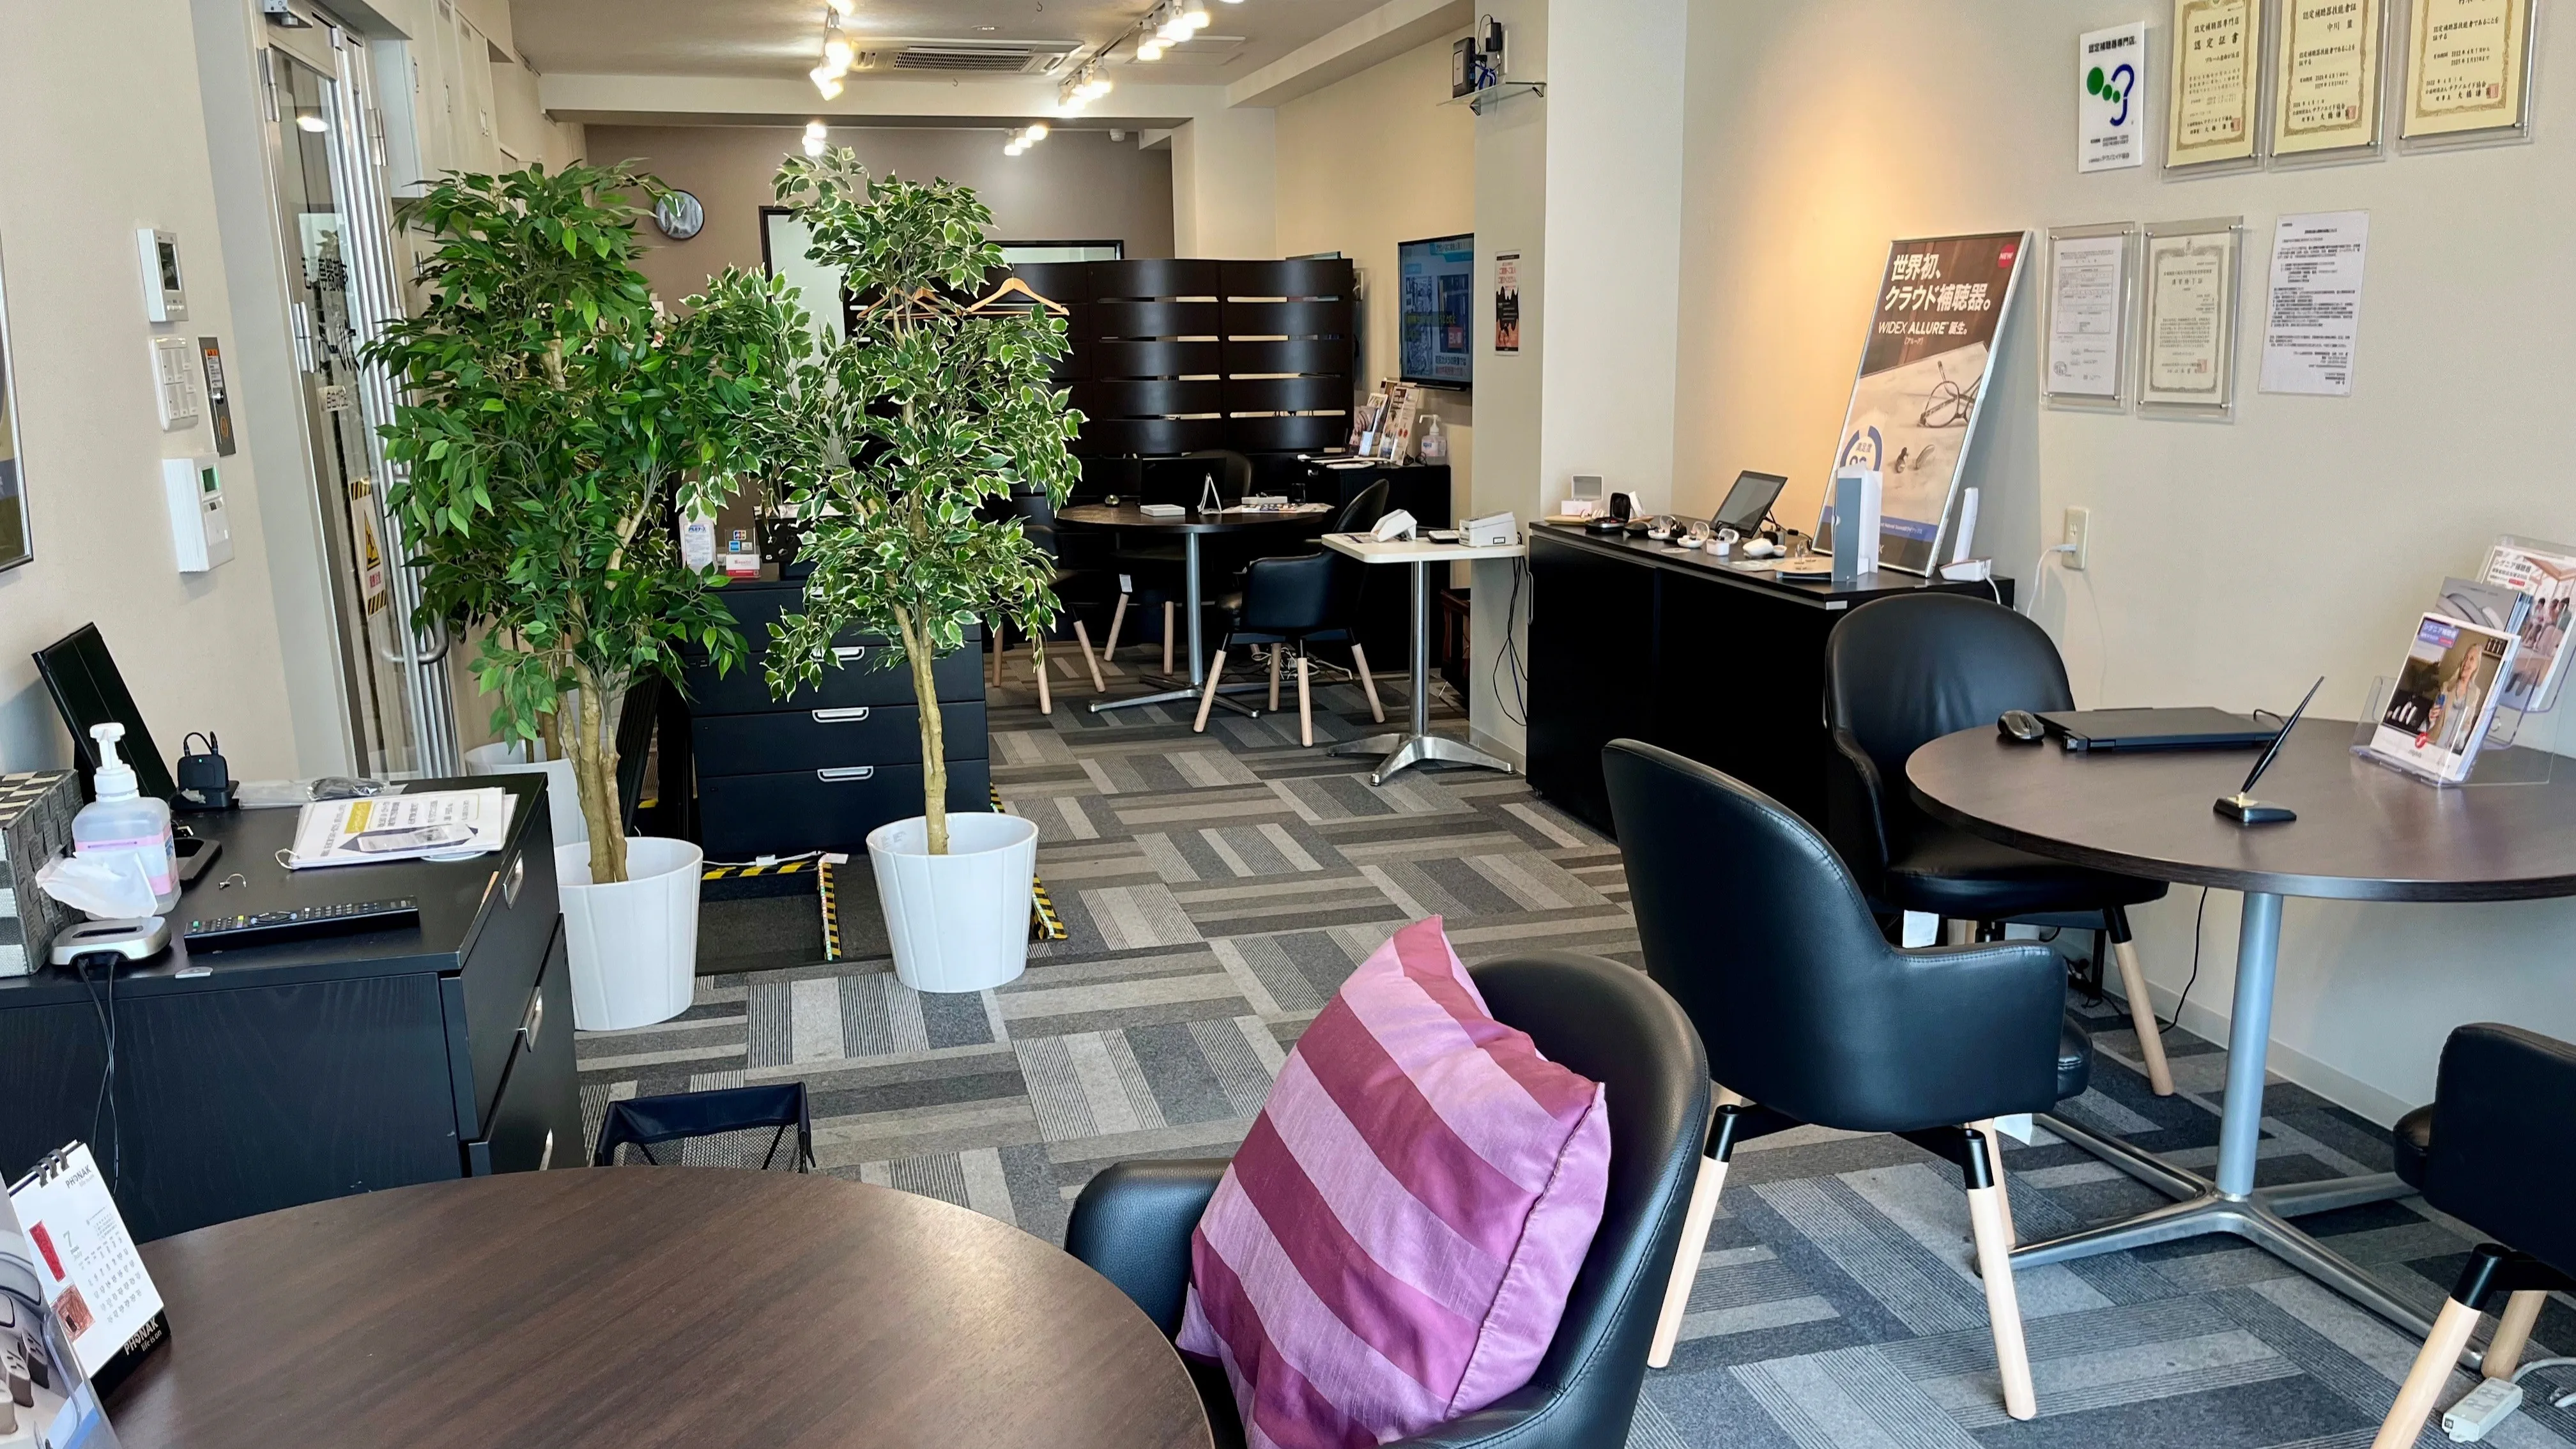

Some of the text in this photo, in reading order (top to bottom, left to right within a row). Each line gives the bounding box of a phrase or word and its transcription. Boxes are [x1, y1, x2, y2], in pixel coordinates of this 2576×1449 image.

[1891, 254, 1941, 281] 世界初、
[1998, 252, 2014, 261] NEW
[1885, 283, 1991, 312] クラウド補聴器。
[1878, 321, 1908, 335] WIDEX
[65, 1165, 92, 1189] PHONAK
[63, 1230, 72, 1248] 7
[123, 1317, 158, 1356] PHONAK
[141, 1340, 150, 1351] life
[155, 1330, 162, 1339] on
